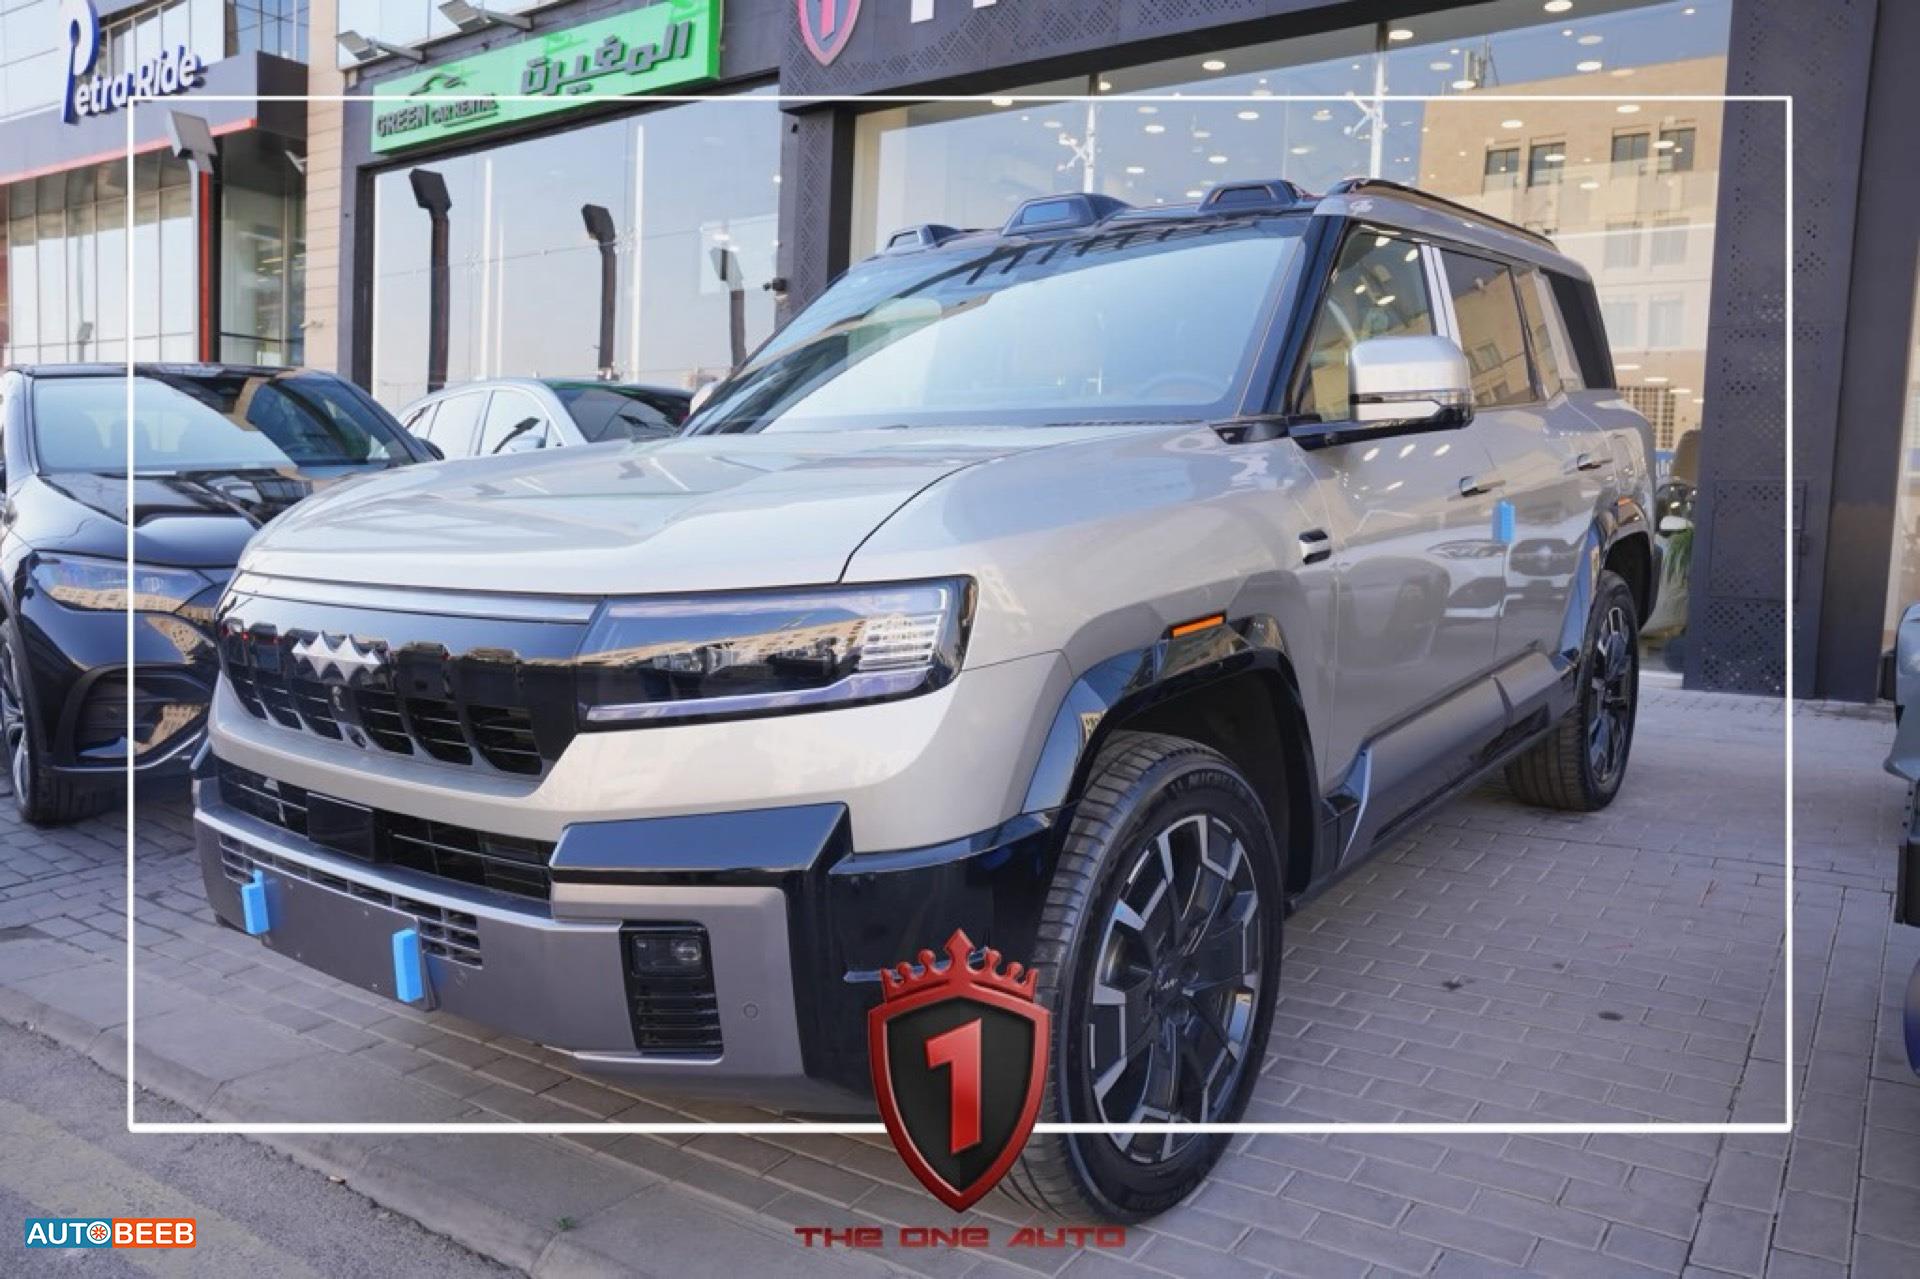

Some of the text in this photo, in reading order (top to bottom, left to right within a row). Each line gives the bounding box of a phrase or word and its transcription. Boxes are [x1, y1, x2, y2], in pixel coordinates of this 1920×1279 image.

[61, 0, 203, 124] Petra Ride
[520, 20, 695, 95] المغيرة
[377, 103, 430, 137] GREEN
